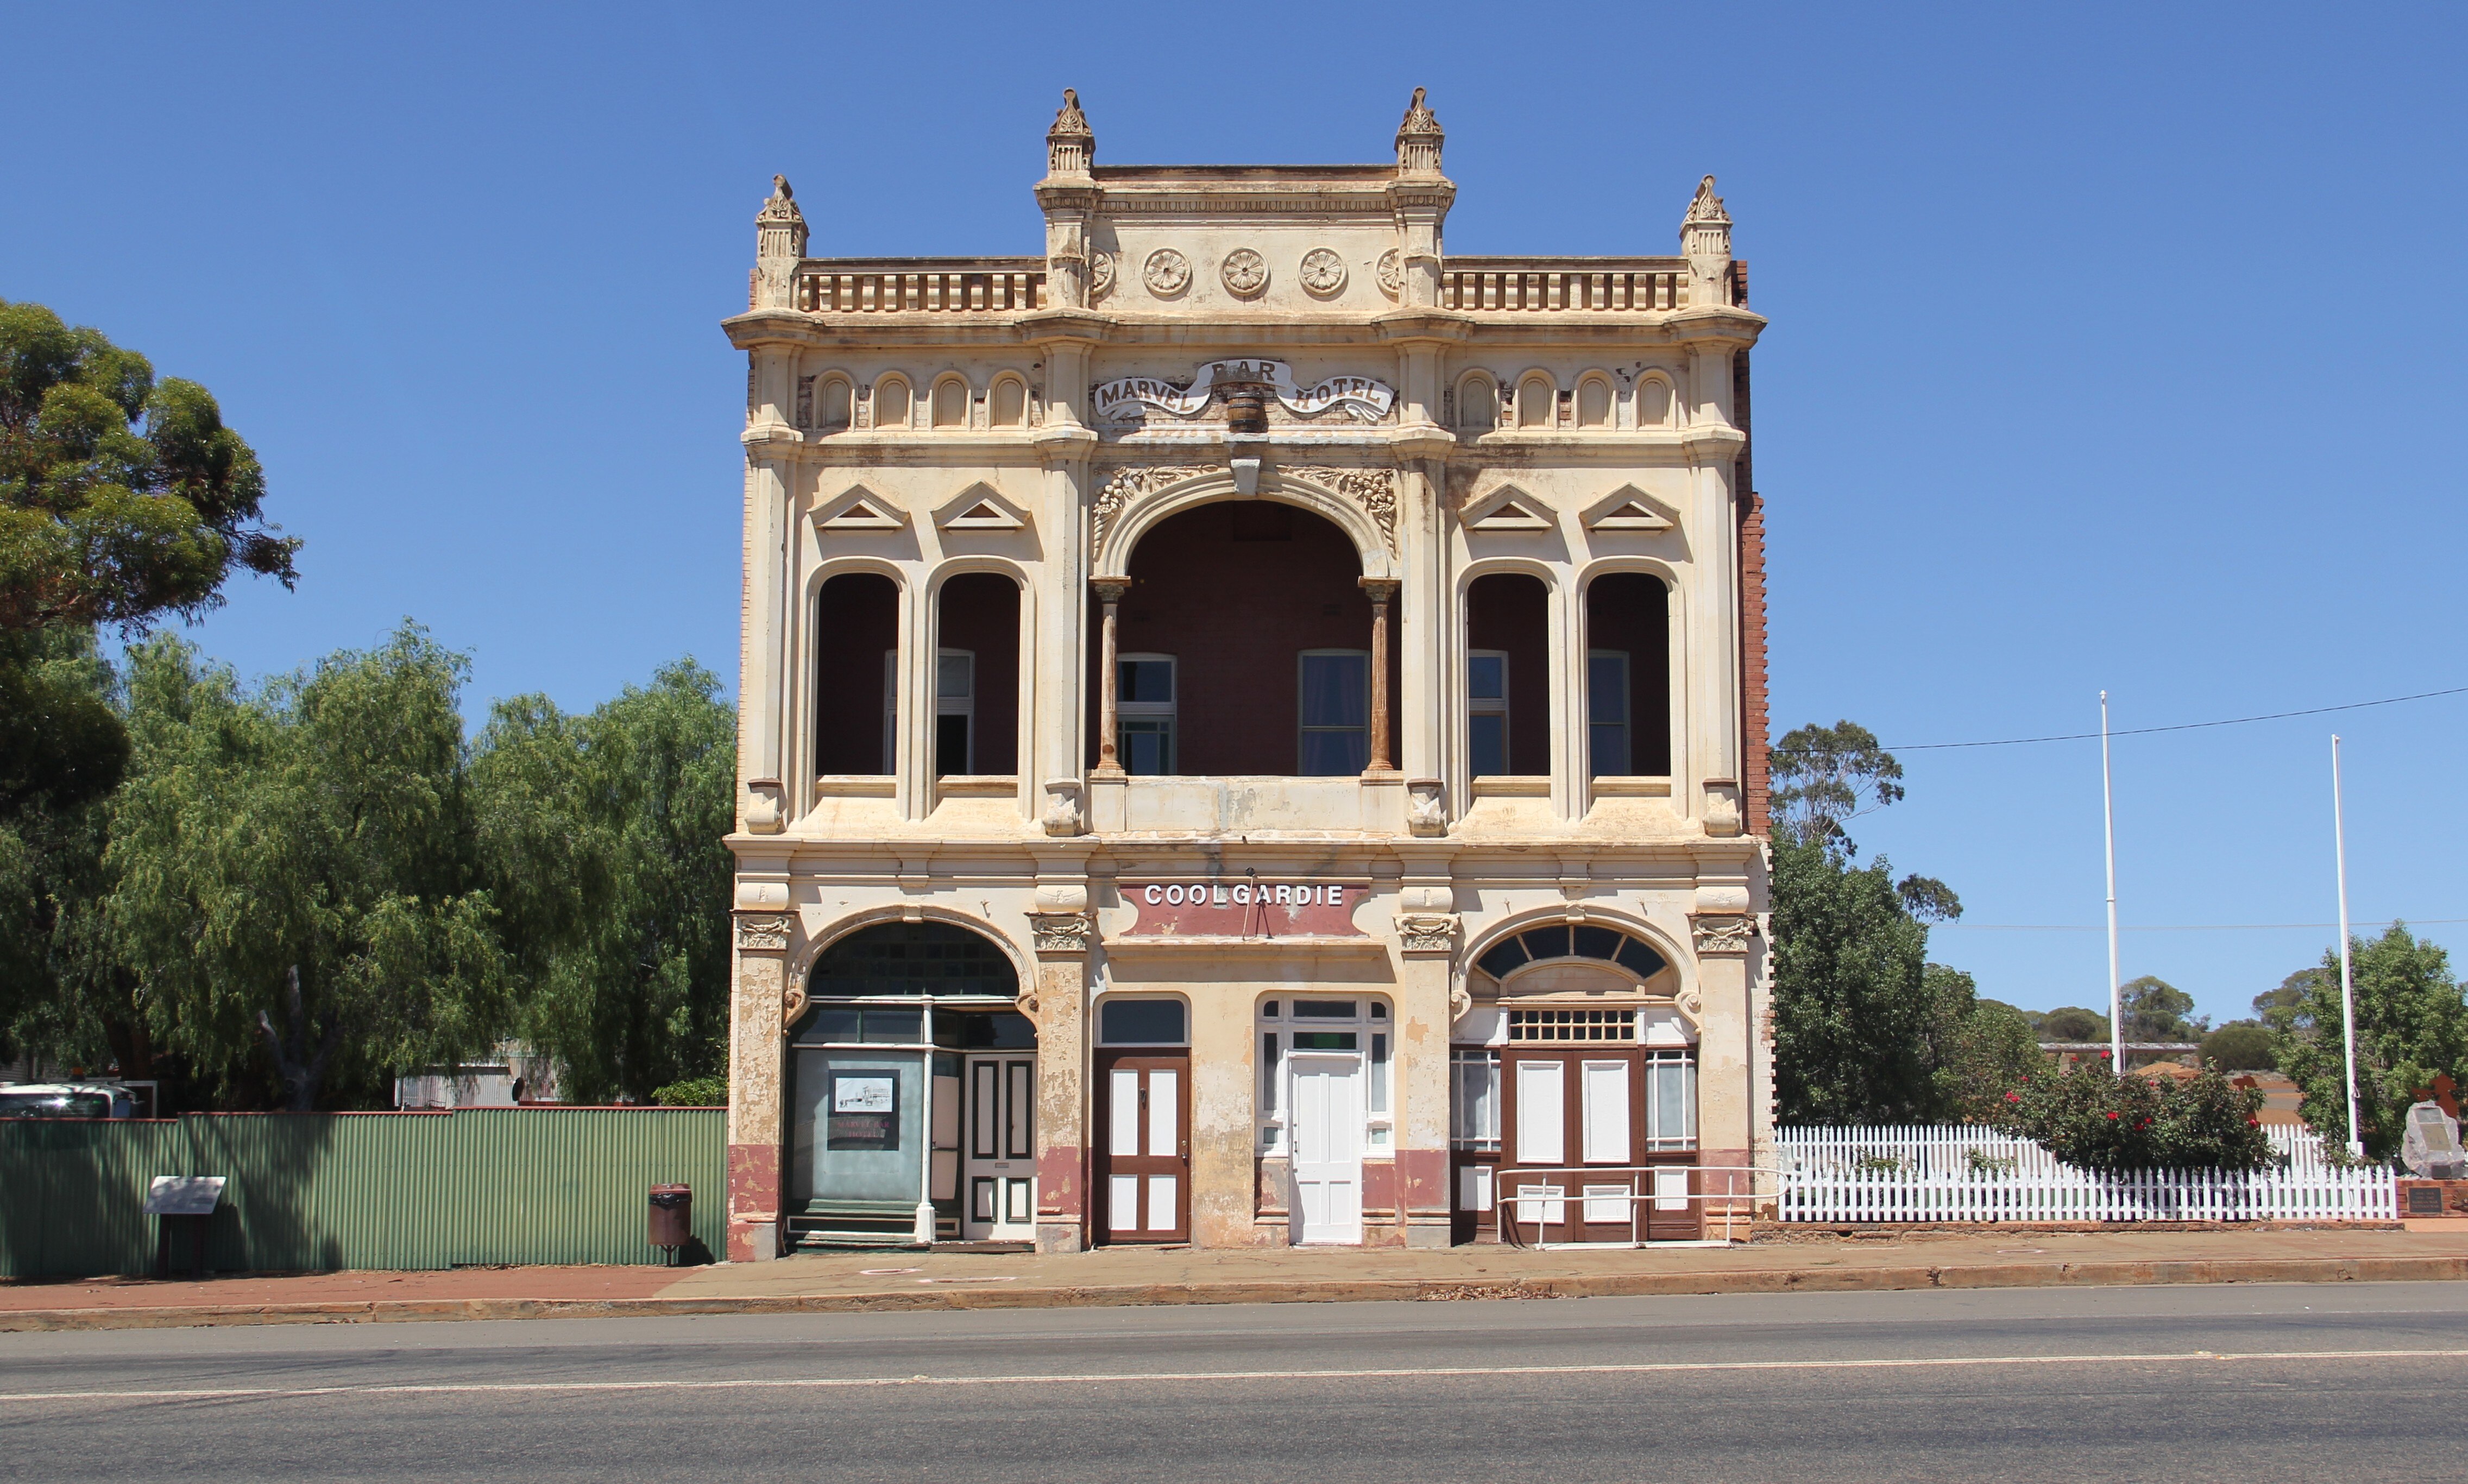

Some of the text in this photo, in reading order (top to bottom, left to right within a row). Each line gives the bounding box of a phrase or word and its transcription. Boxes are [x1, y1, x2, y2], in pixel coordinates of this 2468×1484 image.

[1101, 380, 1194, 411] MARVEL
[1292, 378, 1381, 411] HOTEL
[1144, 884, 1343, 905] COOLGARDIE
